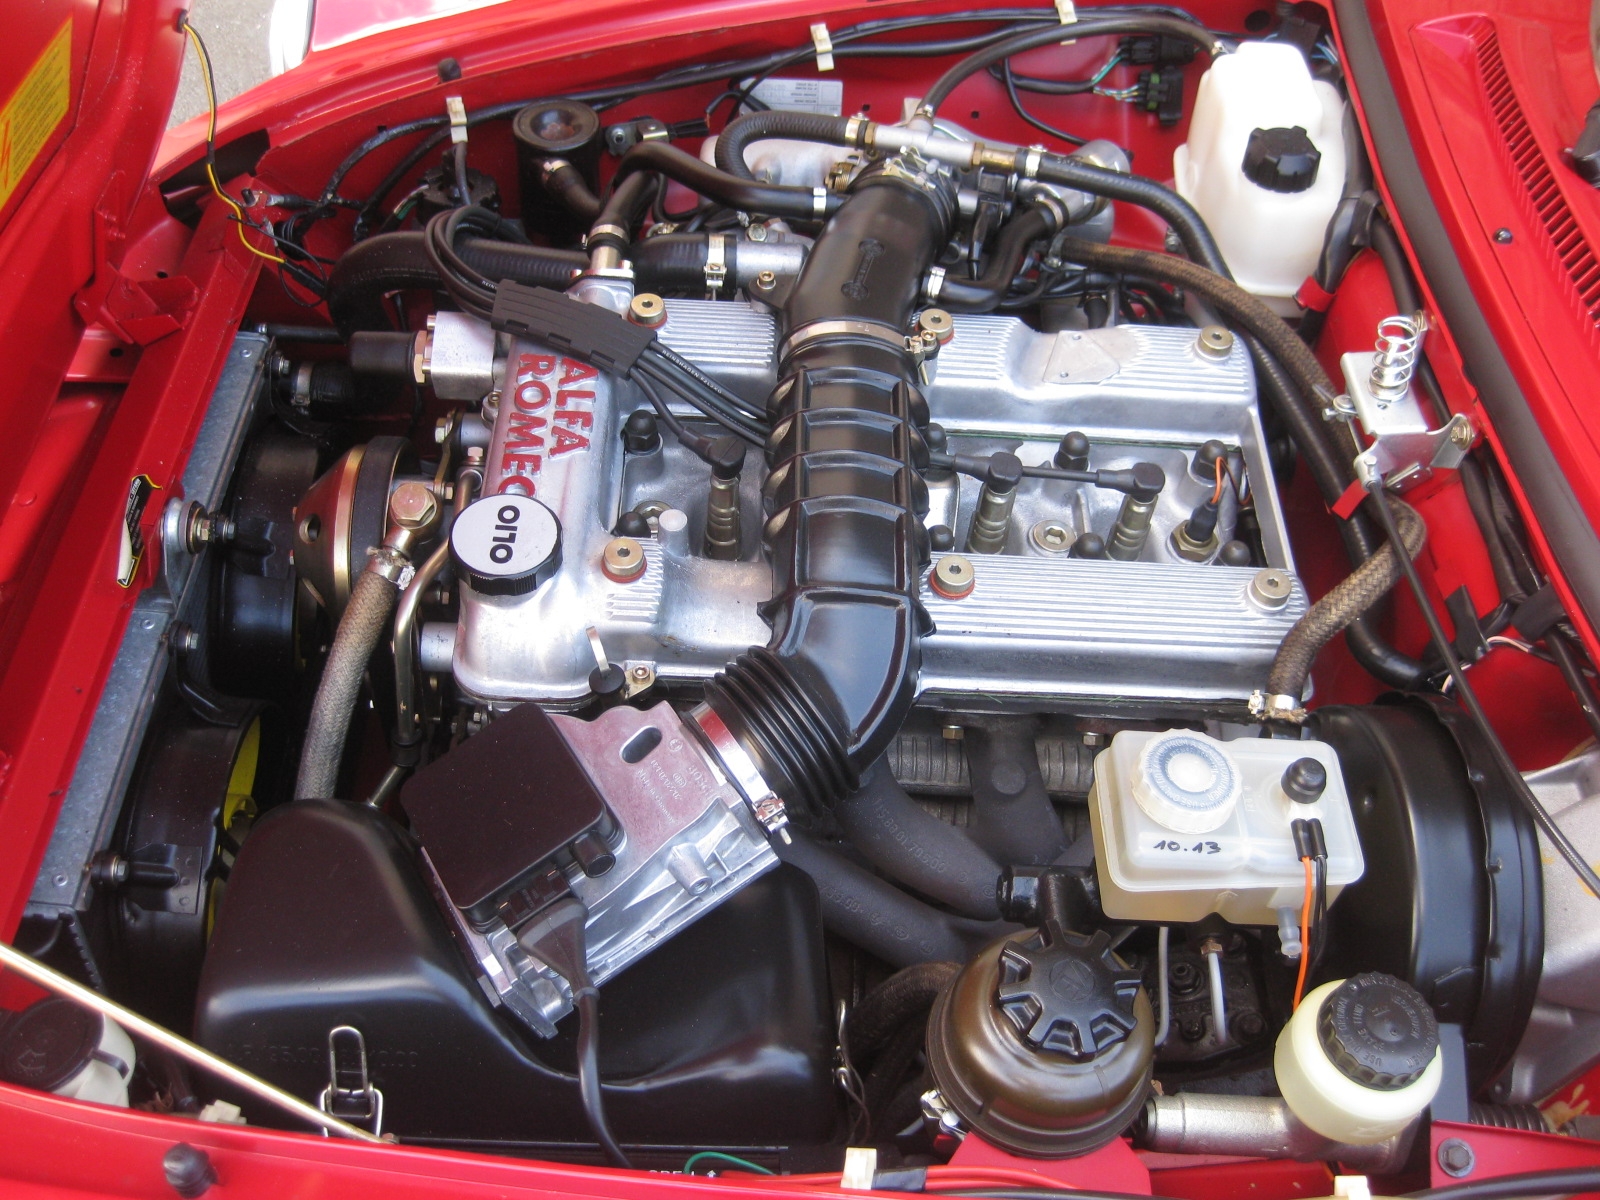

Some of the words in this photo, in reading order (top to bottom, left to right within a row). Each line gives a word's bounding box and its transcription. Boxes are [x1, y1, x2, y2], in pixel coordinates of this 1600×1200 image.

[548, 356, 599, 459] ALFA
[489, 504, 521, 564] OLIO
[1152, 839, 1222, 855] 10.13
